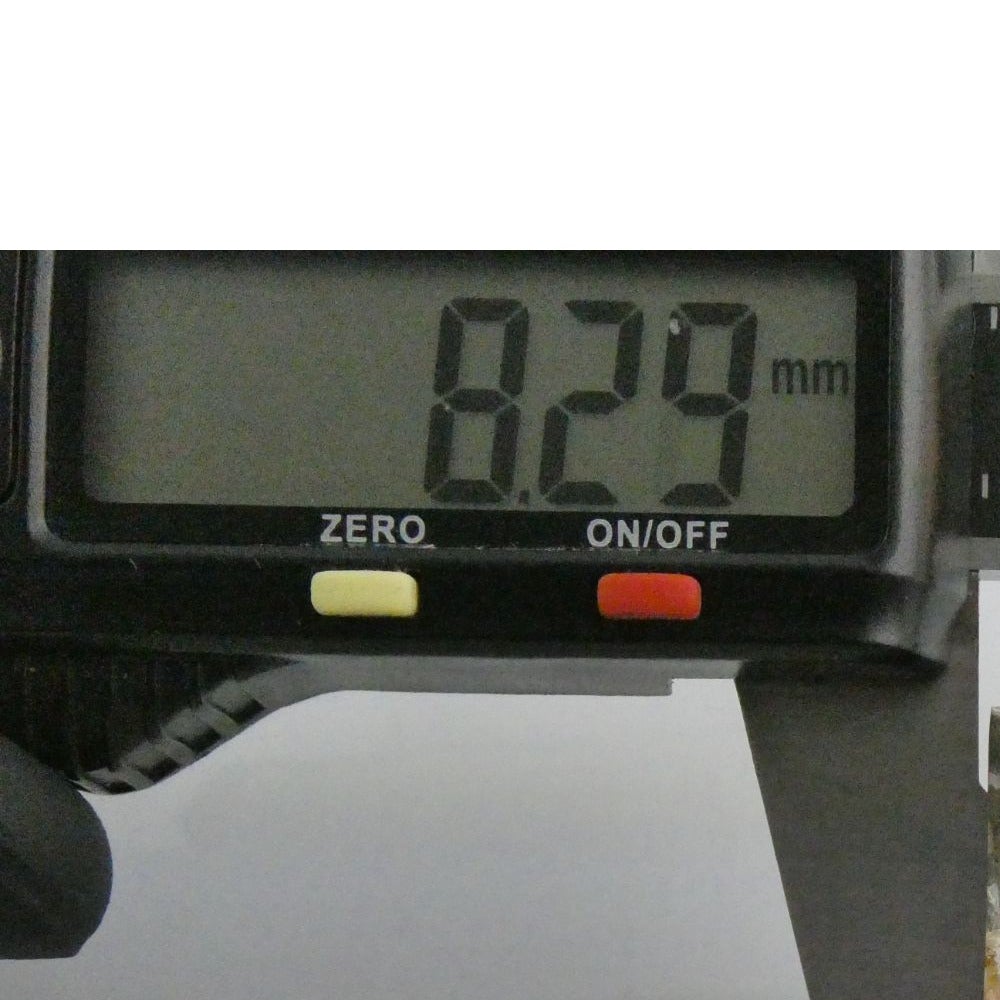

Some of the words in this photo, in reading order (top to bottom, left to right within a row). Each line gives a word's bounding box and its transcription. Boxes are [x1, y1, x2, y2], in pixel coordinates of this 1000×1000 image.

[772, 358, 850, 395] mm
[320, 513, 426, 544] ZERO
[586, 518, 729, 550] ON/OFF
